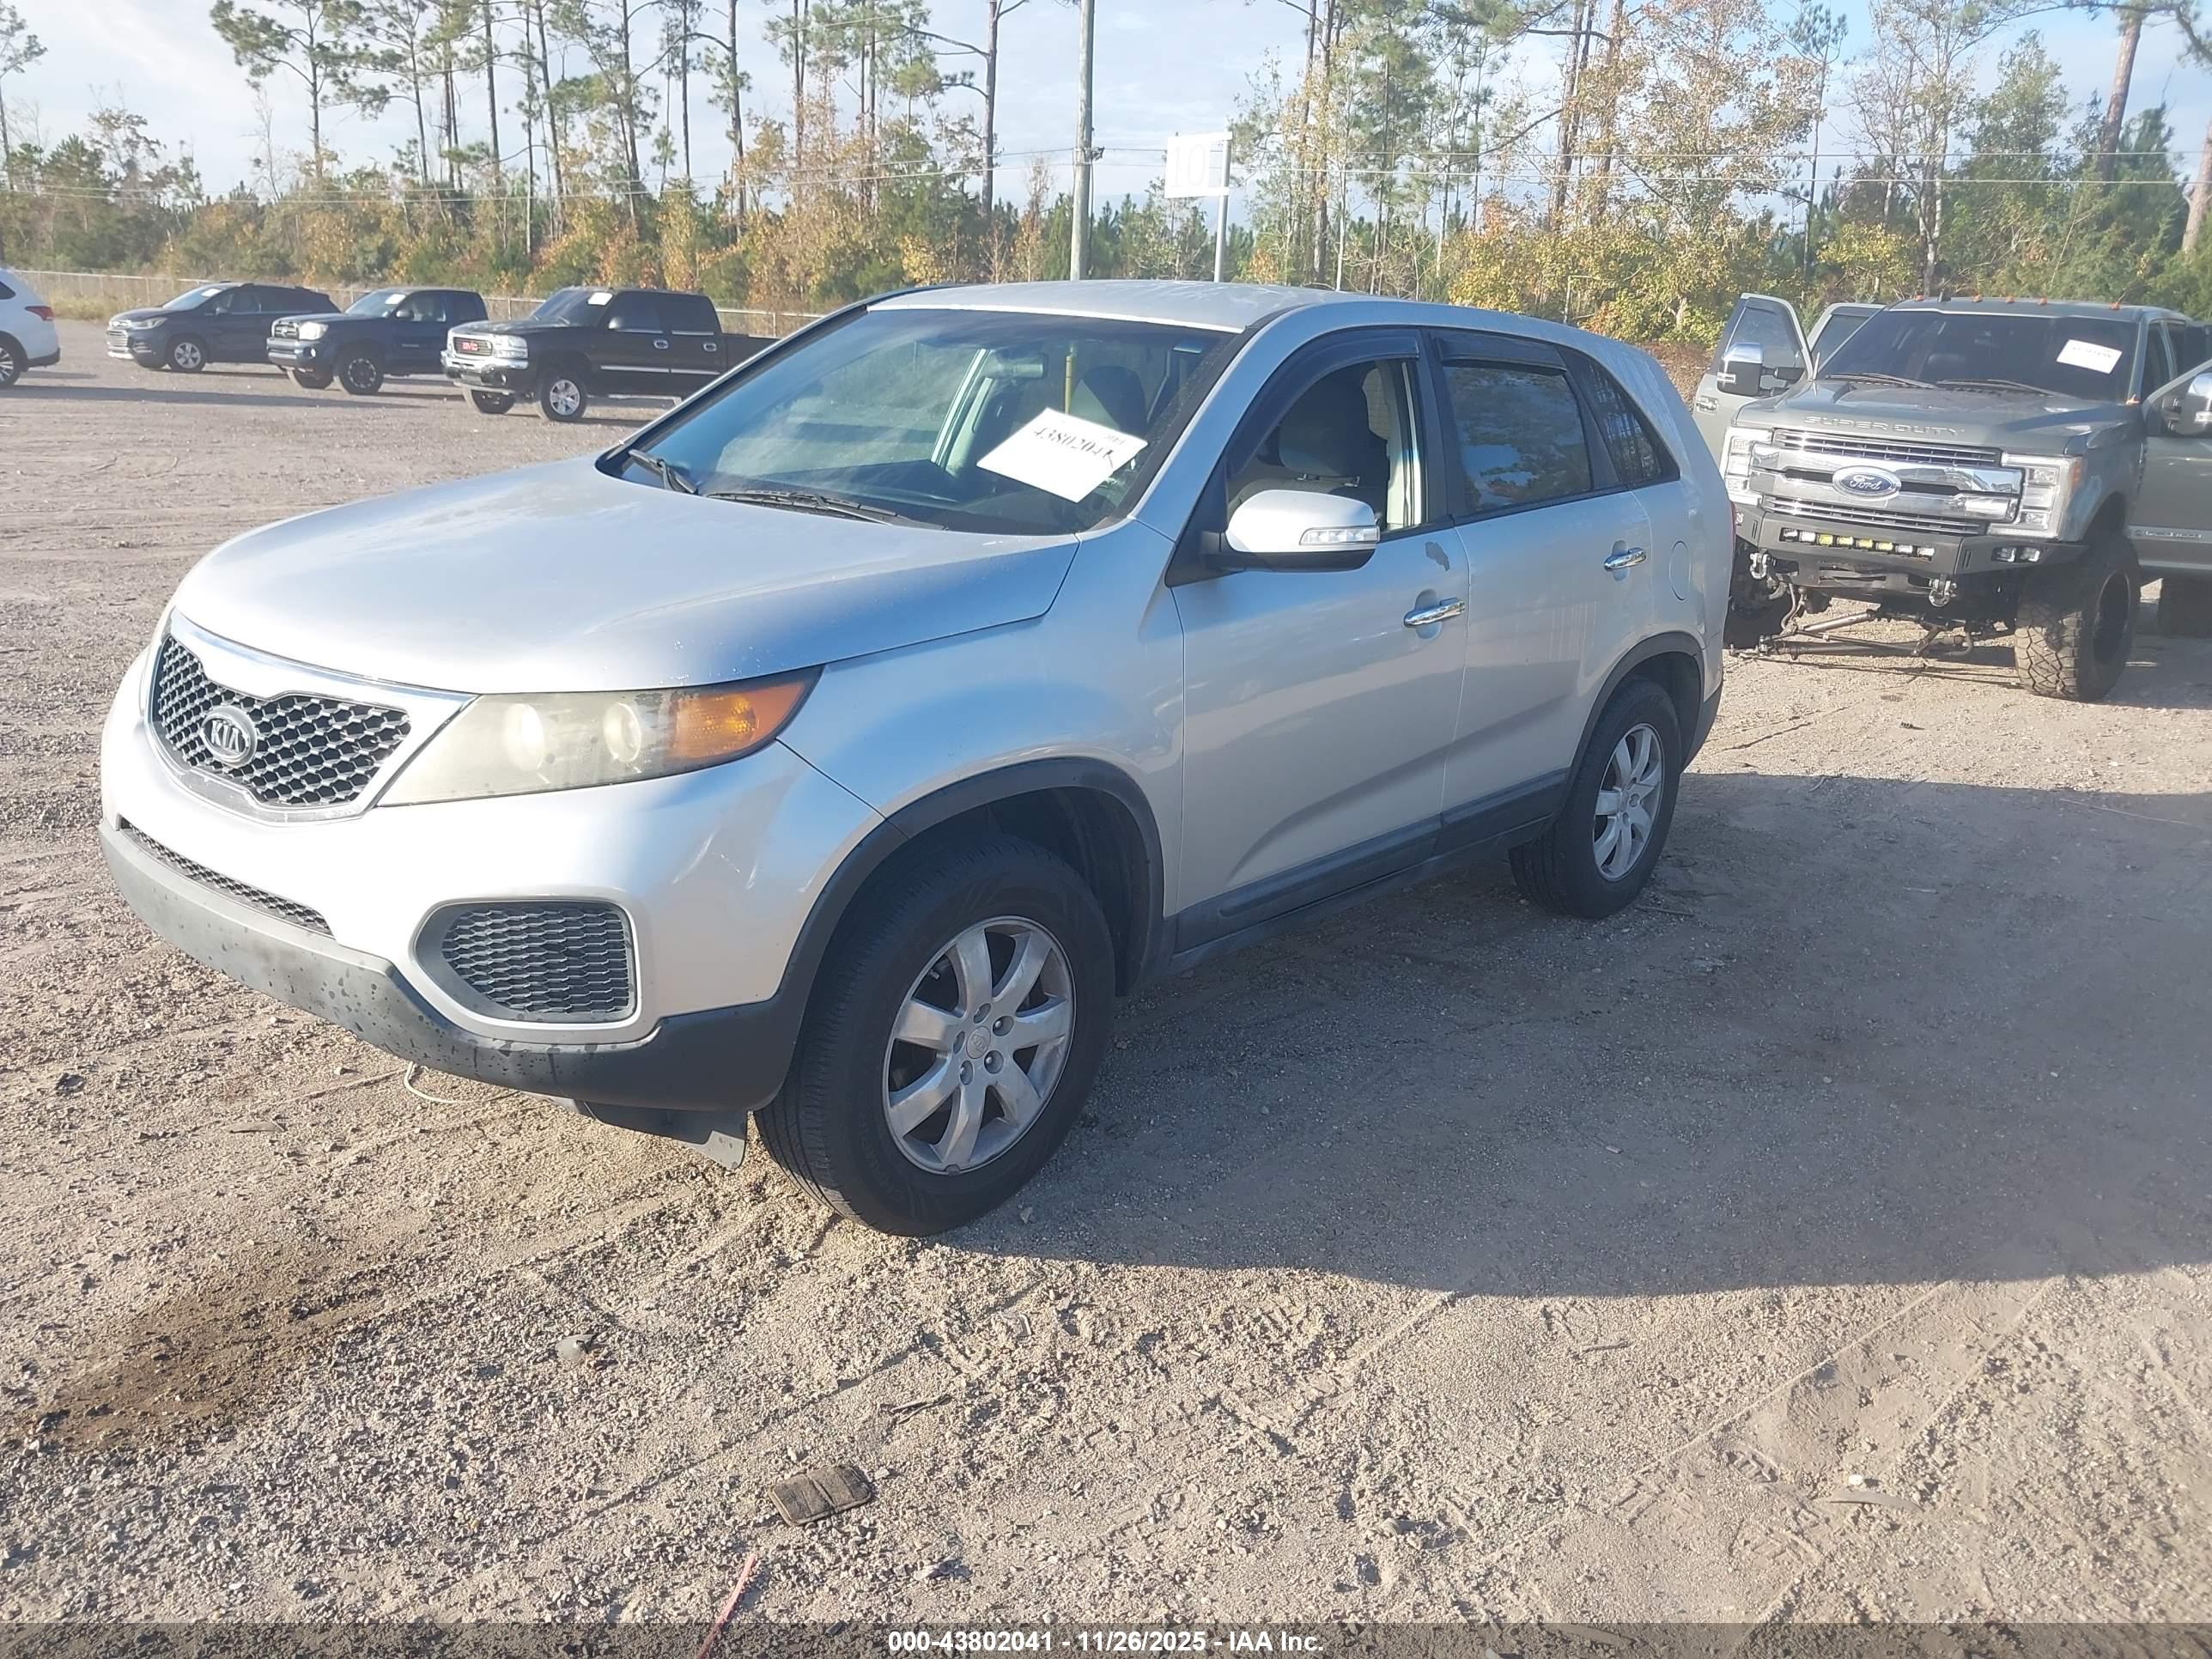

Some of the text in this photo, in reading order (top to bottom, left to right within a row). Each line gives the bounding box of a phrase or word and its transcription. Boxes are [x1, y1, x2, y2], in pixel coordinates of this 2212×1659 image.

[1804, 415, 1959, 436] SUPER DUTY
[1849, 474, 1883, 490] Ford
[210, 720, 240, 753] KIA
